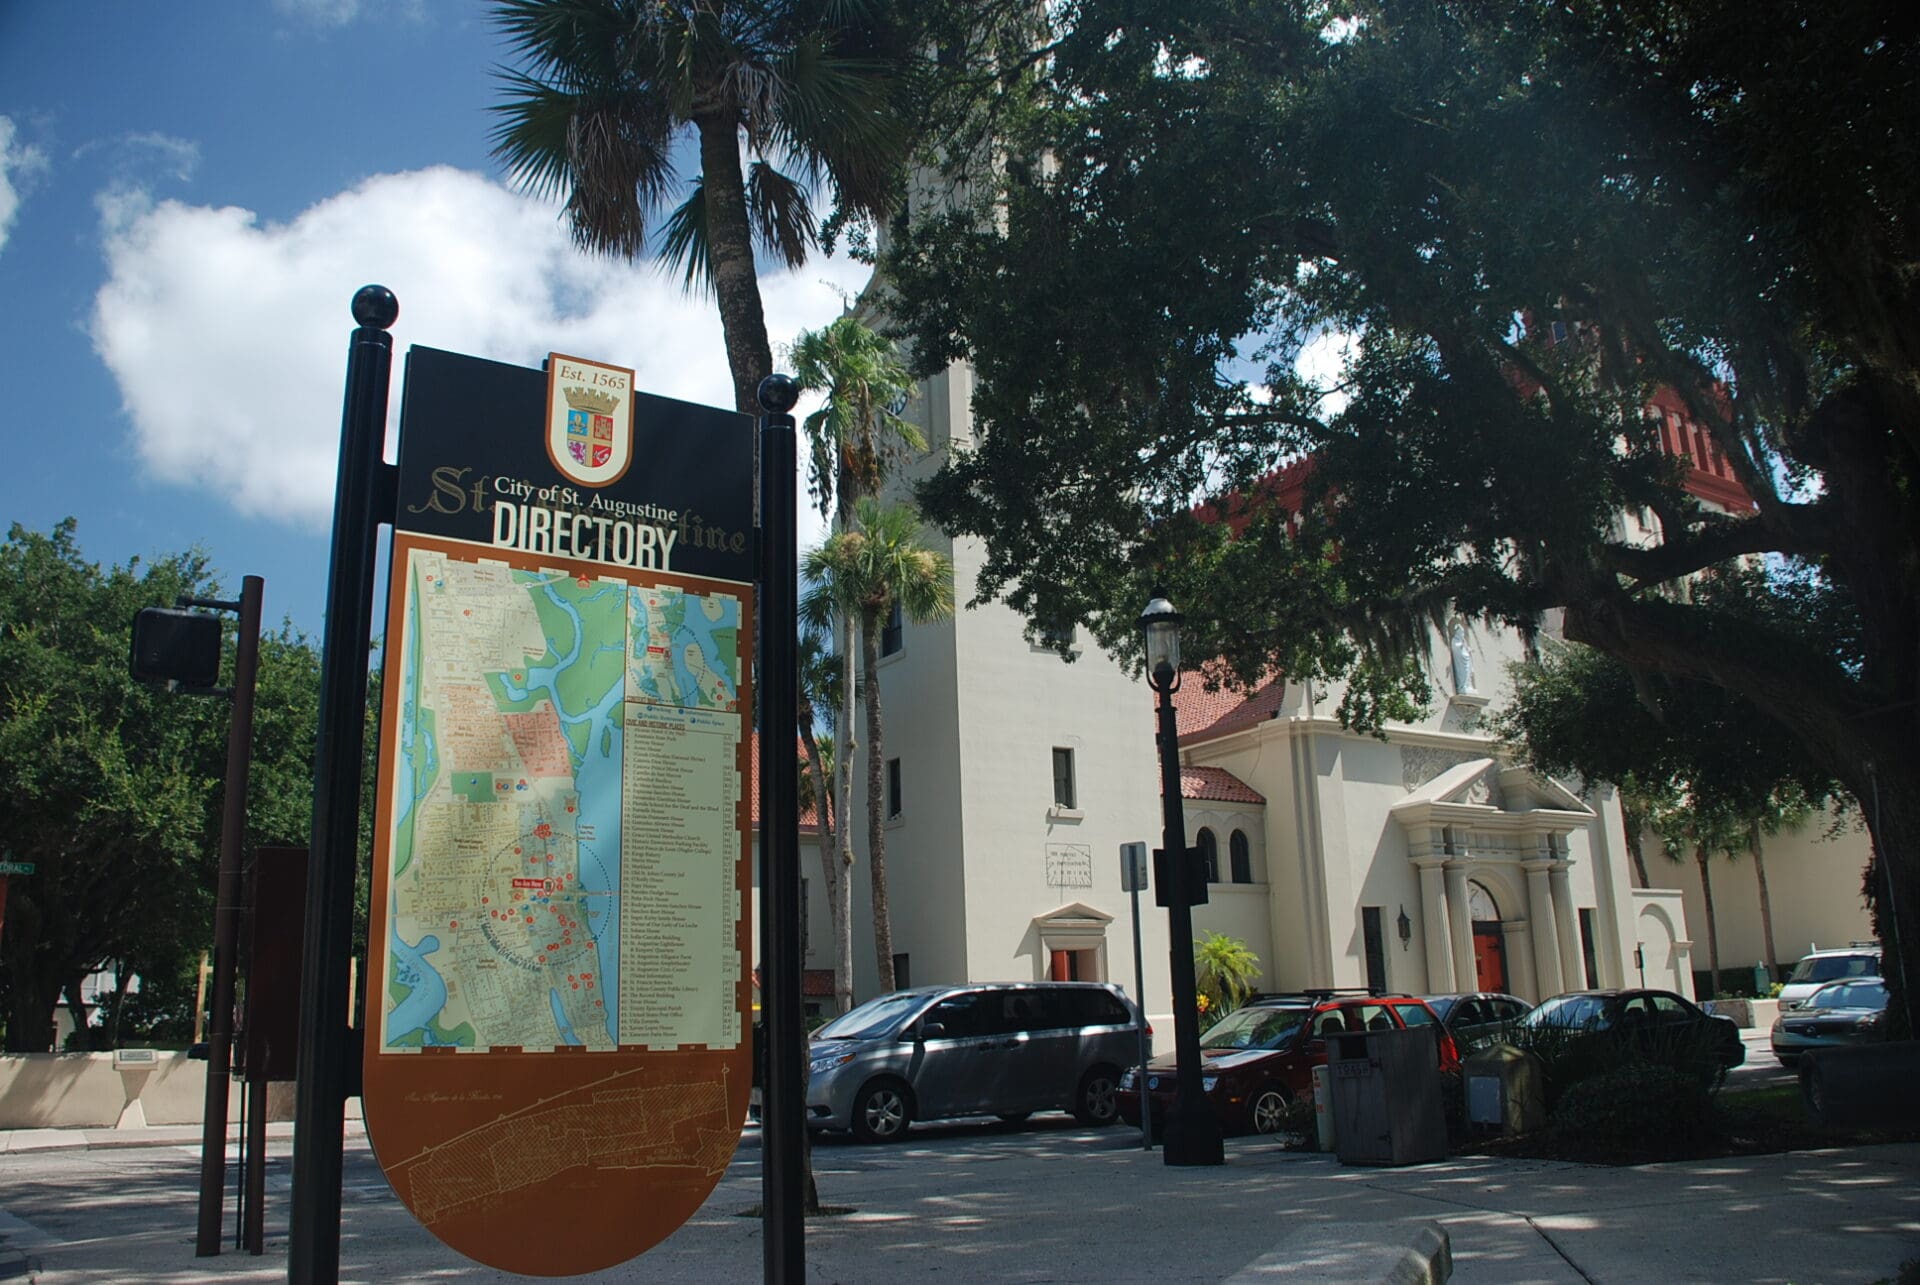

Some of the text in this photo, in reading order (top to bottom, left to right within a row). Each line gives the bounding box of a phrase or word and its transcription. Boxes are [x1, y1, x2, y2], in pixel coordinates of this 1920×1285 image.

[560, 364, 626, 390] Est. 1565
[494, 476, 678, 522] City of St. Augustine
[492, 500, 678, 572] DIRECTORY
